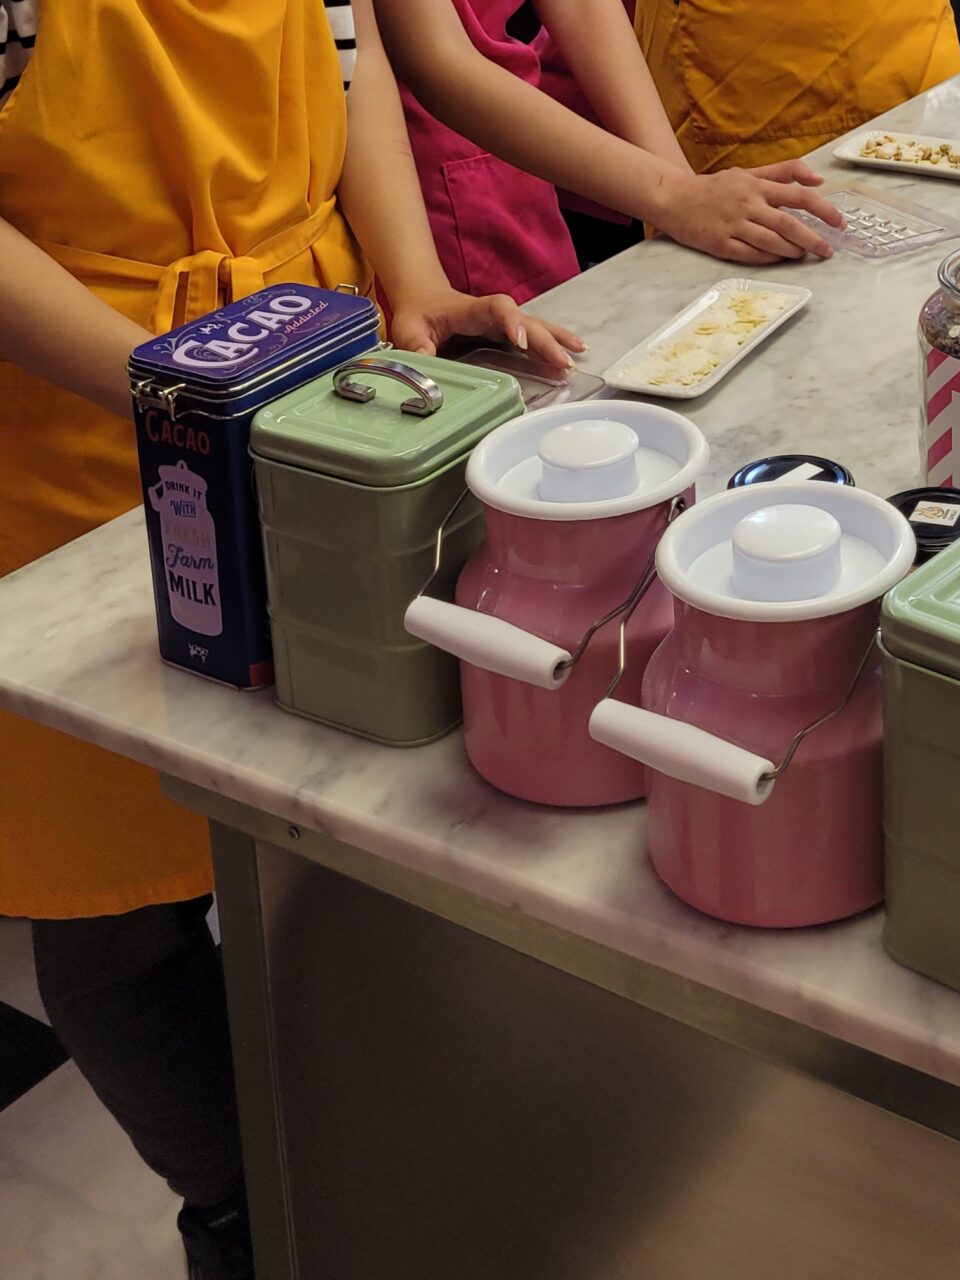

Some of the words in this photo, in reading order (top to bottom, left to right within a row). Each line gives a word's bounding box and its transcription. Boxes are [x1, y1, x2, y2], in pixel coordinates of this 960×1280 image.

[172, 295, 312, 368] CACAO
[284, 301, 328, 334] Addicted
[146, 410, 211, 455] CACAO
[165, 481, 191, 494] DRINK
[193, 487, 202, 500] IT
[166, 544, 214, 569] Farm
[168, 570, 216, 606] MILK
